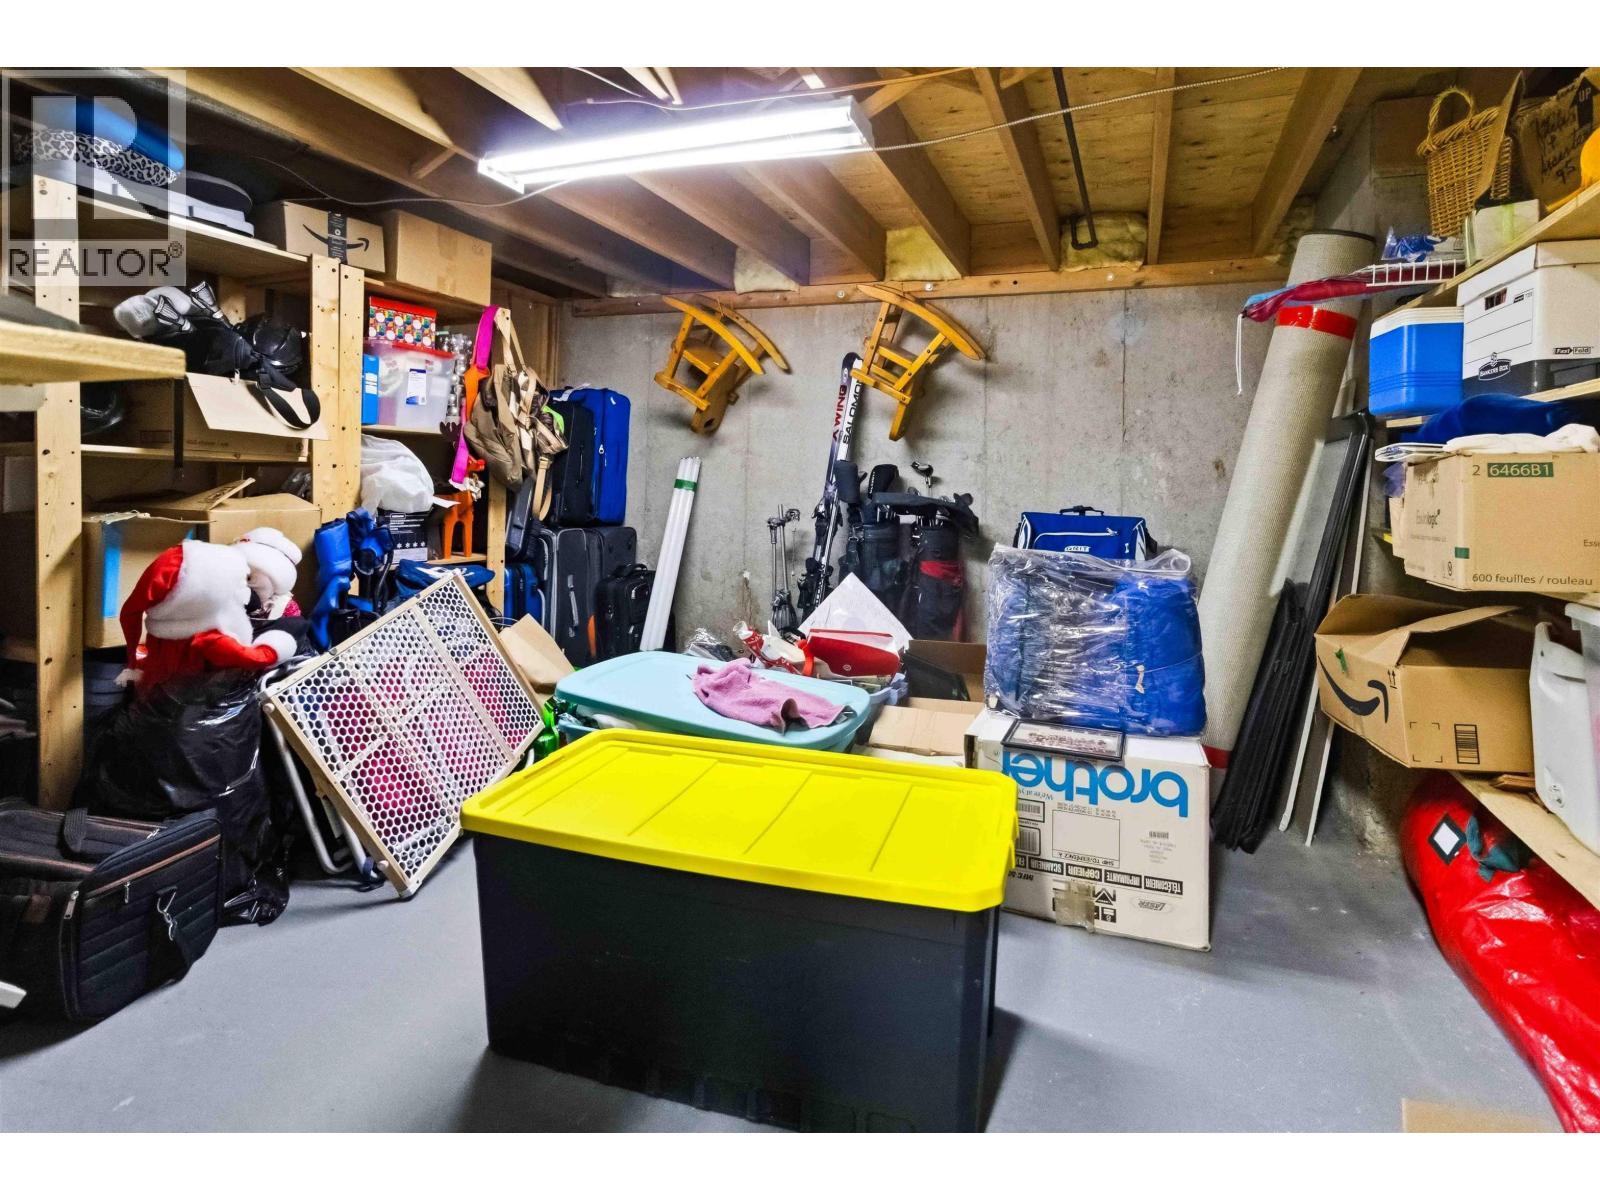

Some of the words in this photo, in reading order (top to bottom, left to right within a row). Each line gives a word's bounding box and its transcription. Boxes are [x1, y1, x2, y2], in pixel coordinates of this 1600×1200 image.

[1578, 87, 1592, 102] UP
[1472, 464, 1480, 476] 2
[1489, 463, 1552, 477] 6466B1
[1472, 573, 1493, 584] 600
[1495, 573, 1536, 585] feuilles
[1539, 574, 1544, 585] /
[1547, 575, 1593, 586] rouleau
[1003, 752, 1189, 818] brother
[1067, 865, 1101, 880] COPIEUR
